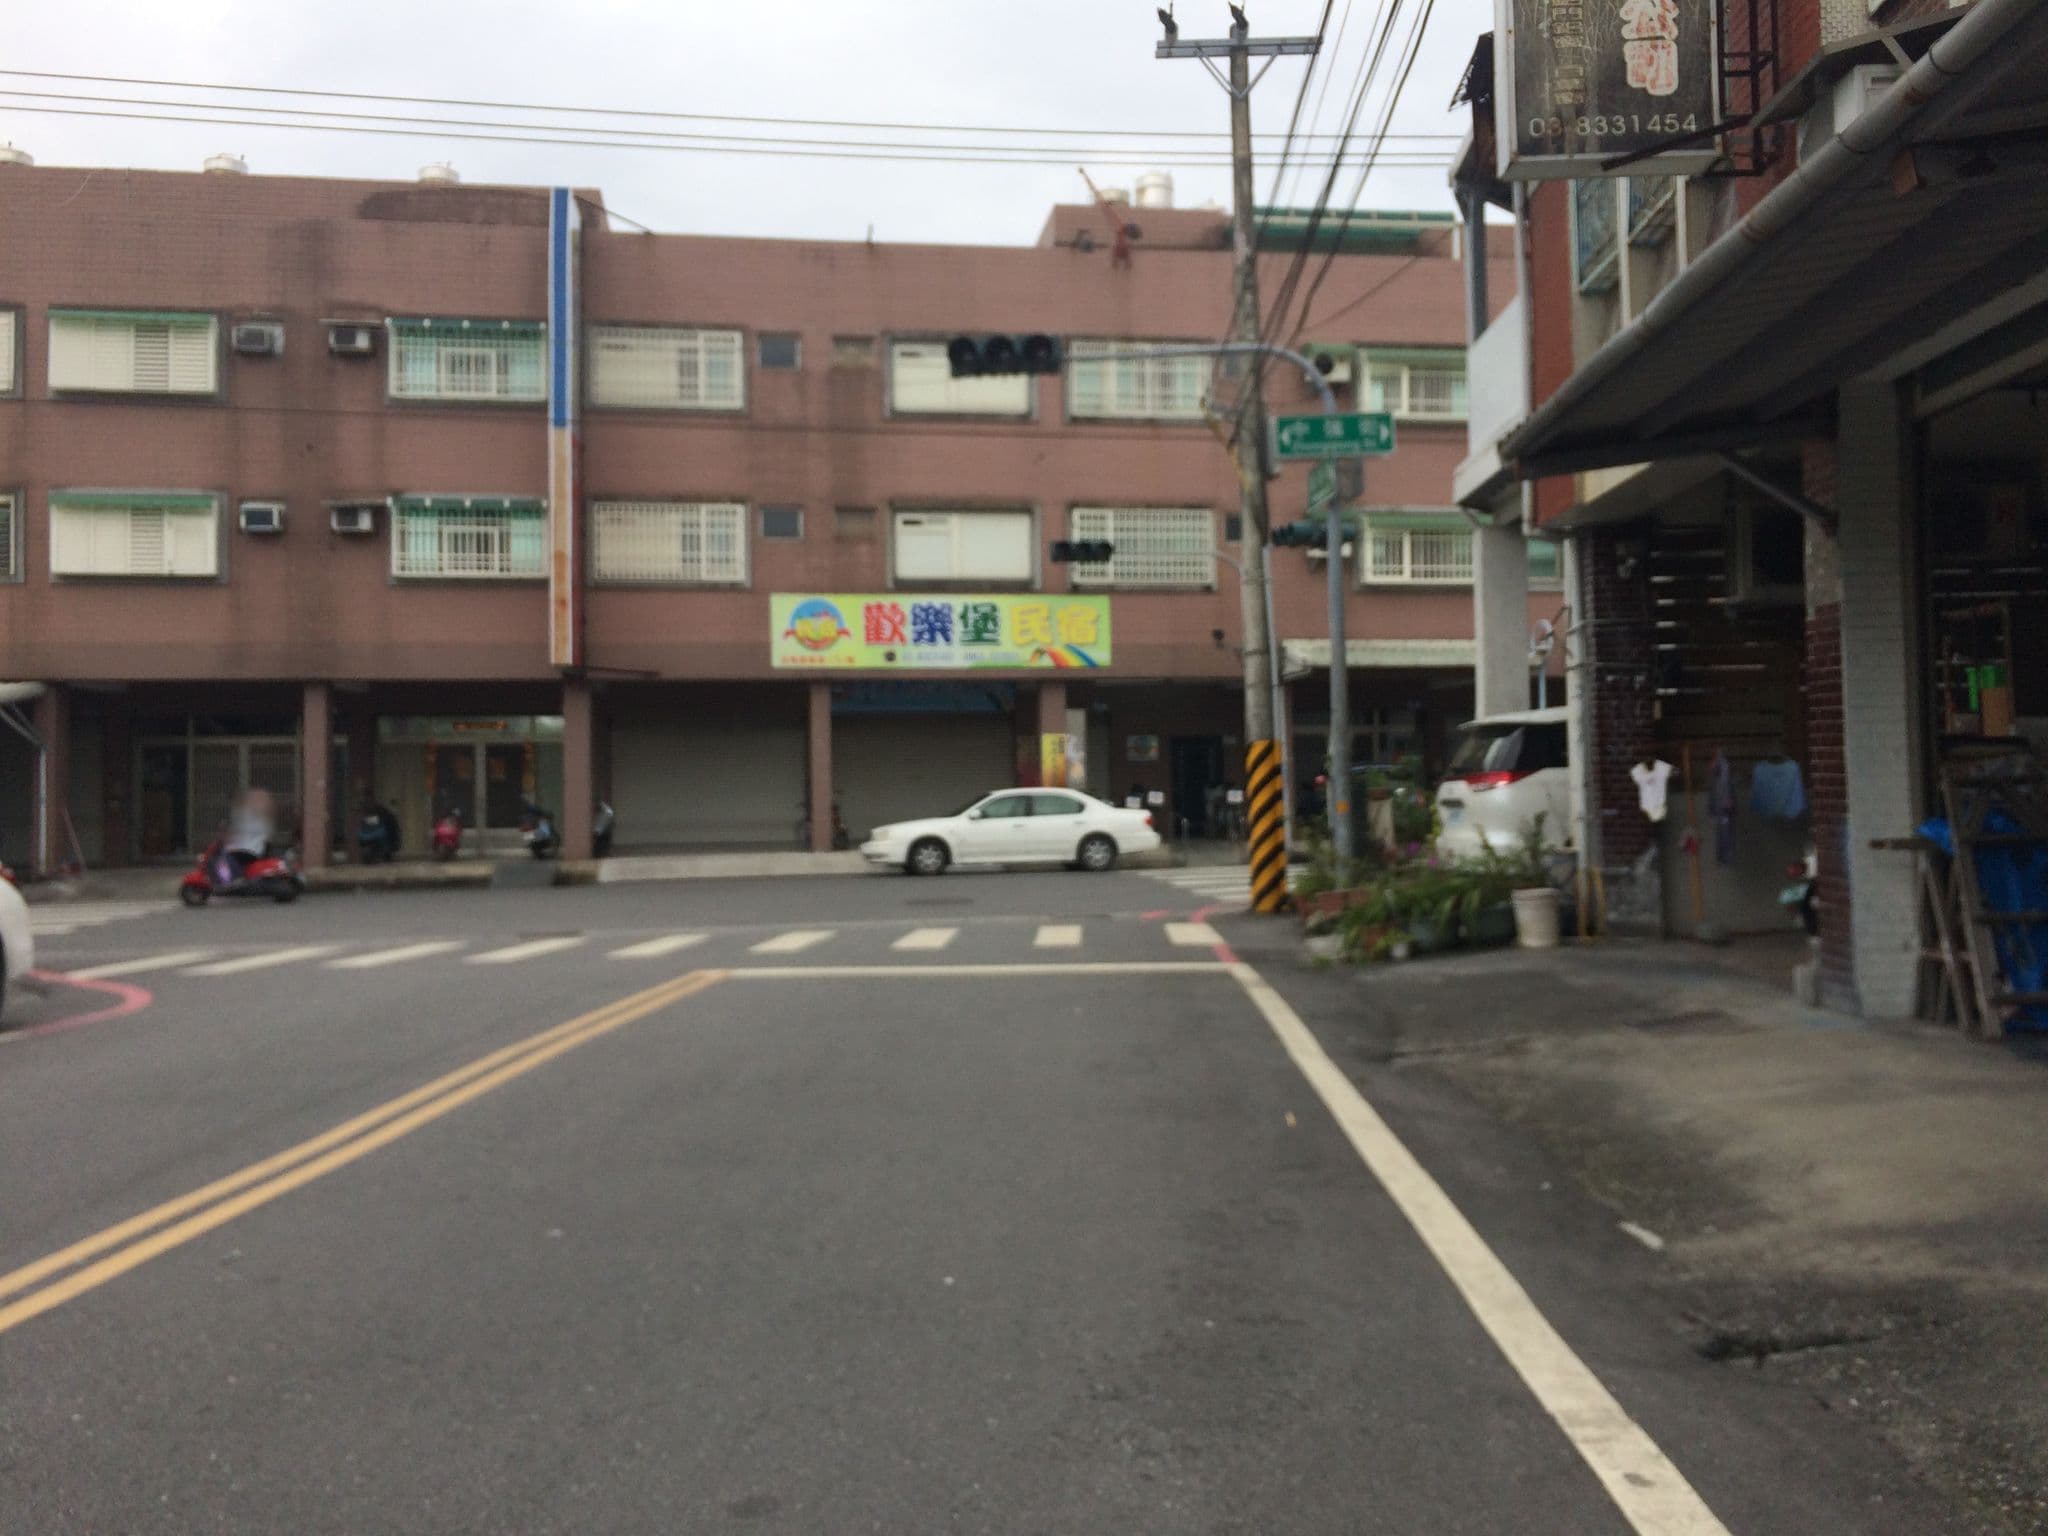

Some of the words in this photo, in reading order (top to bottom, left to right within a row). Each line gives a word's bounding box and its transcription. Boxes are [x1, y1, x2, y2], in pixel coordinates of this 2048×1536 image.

[1577, 114, 1698, 137] 8331454
[865, 600, 1101, 645] 歡樂堡民宿
